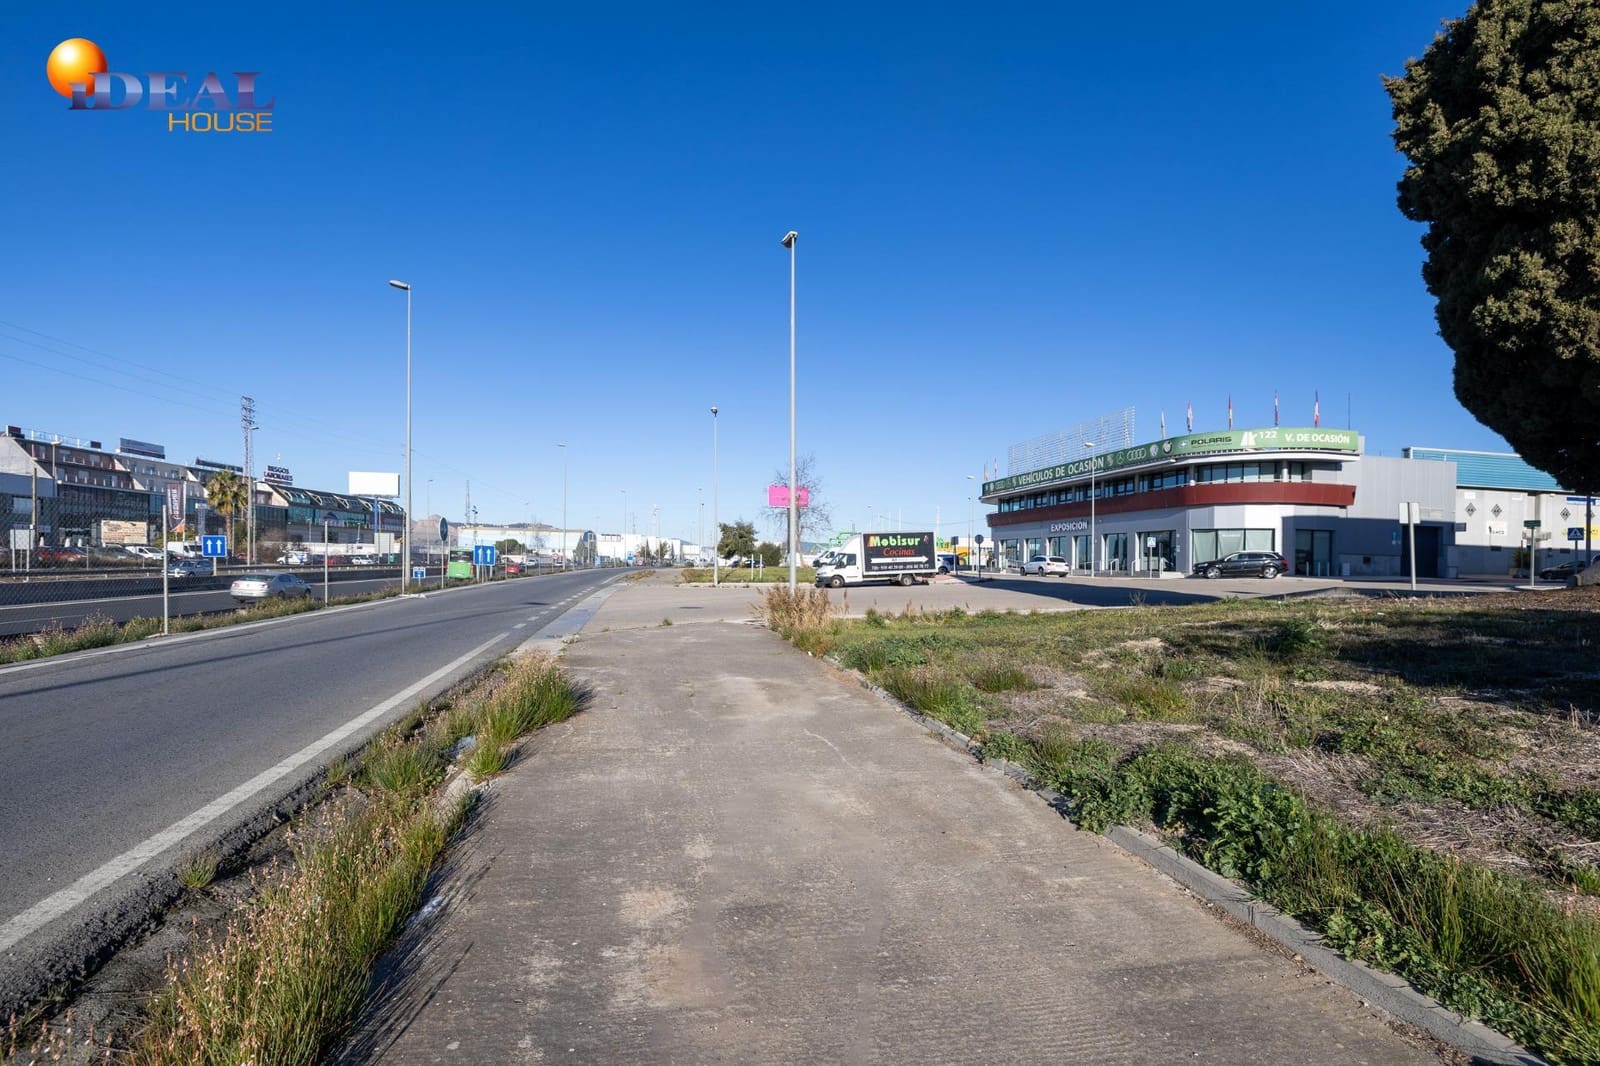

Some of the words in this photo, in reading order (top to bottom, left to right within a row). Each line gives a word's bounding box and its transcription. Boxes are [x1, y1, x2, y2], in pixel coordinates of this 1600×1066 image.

[1259, 431, 1277, 439] 122
[1285, 434, 1294, 442] V.
[1297, 434, 1311, 442] DE
[1312, 433, 1350, 444] OCASIÓN
[1190, 436, 1232, 445] POLARIS
[1018, 469, 1053, 484] VEHÍCULOS
[1055, 466, 1065, 477] DE
[1068, 456, 1104, 475] OCASIÓN
[867, 535, 921, 548] Mobisur
[882, 547, 915, 556] Cocinas
